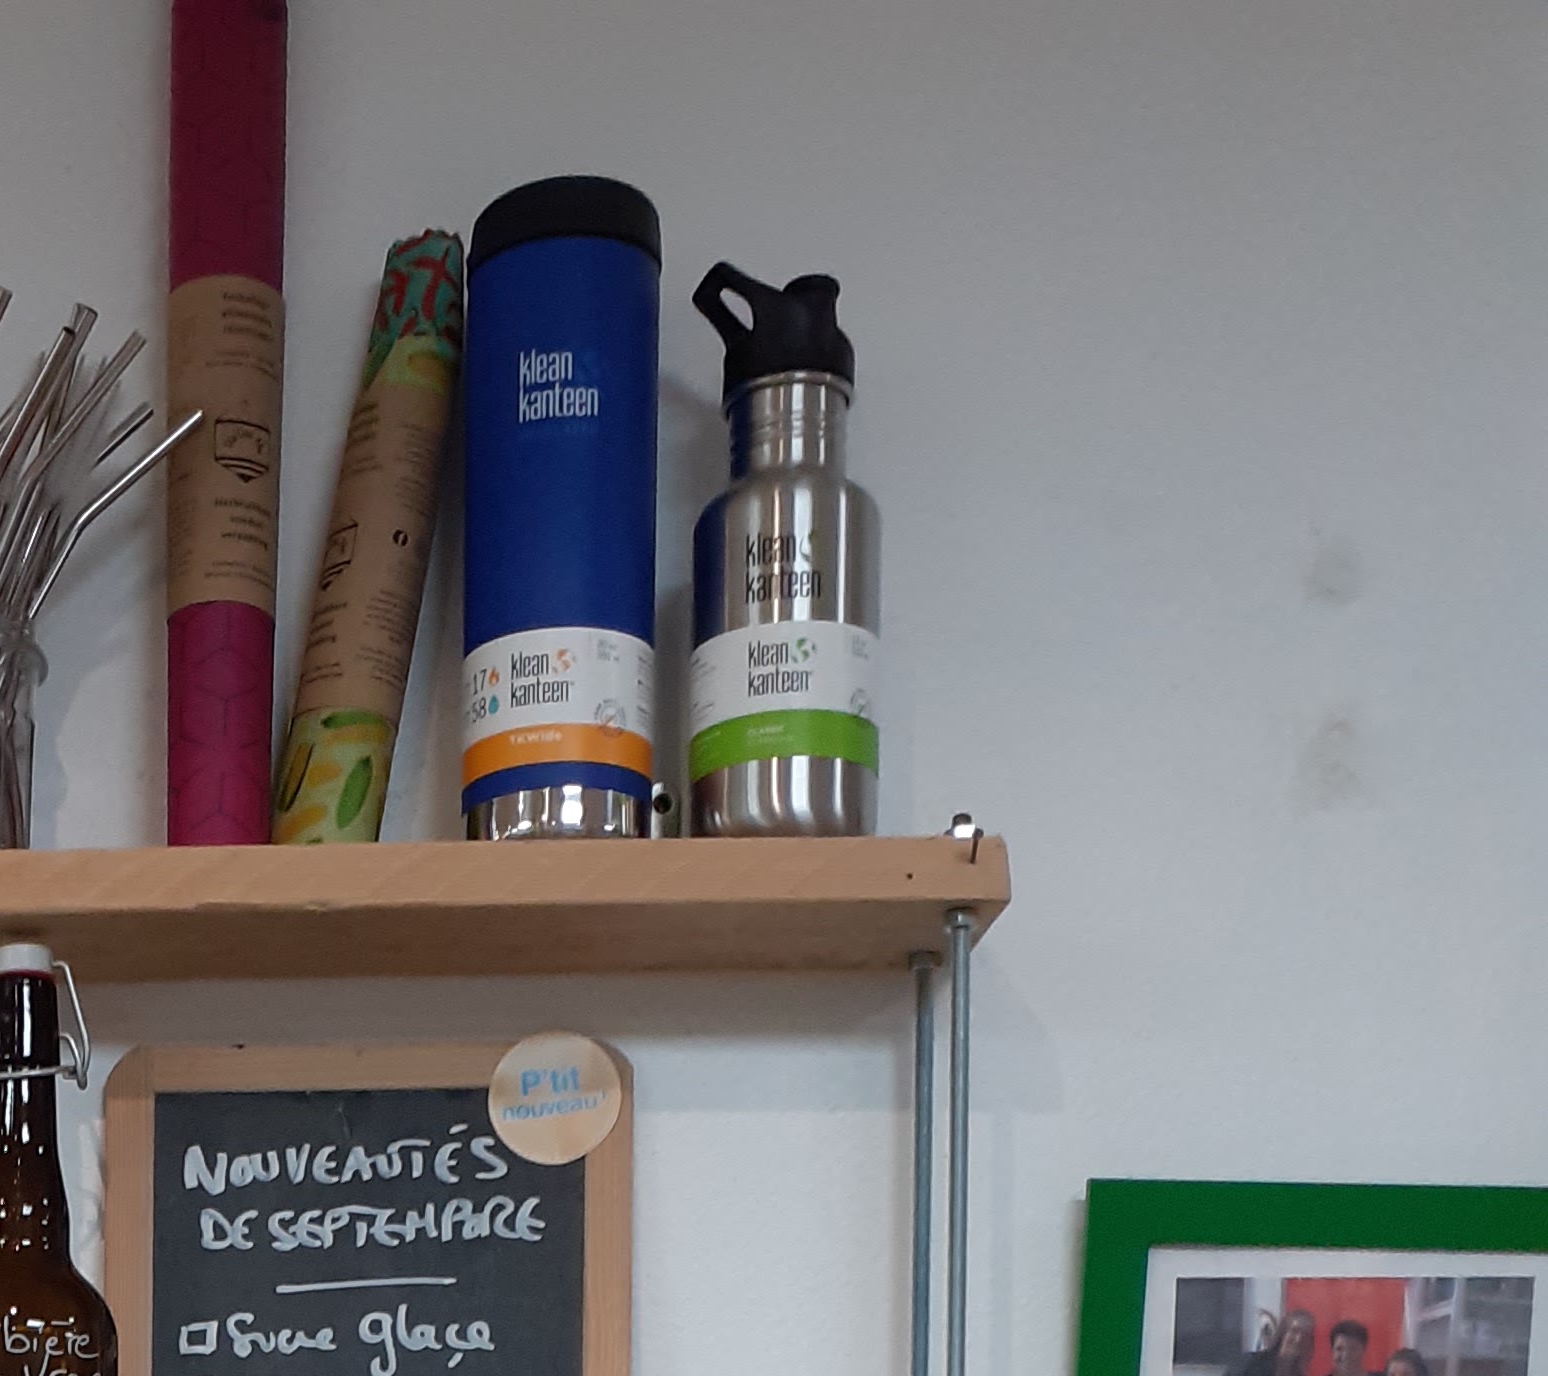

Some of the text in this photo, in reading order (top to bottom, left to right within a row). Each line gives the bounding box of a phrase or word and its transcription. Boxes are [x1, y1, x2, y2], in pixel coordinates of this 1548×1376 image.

[519, 349, 572, 387] klean
[519, 382, 599, 423] kanteen
[745, 533, 797, 569] klean
[510, 652, 549, 681] klean
[748, 640, 789, 669] klean
[472, 669, 487, 695] 17
[510, 677, 570, 708] kanteen
[748, 666, 810, 698] kanteen
[471, 697, 488, 723] 58
[519, 1066, 580, 1096] P'tit
[502, 1096, 597, 1121] nouveau
[183, 1124, 508, 1196] NOUVEAUTÉS
[199, 1207, 259, 1251] DE
